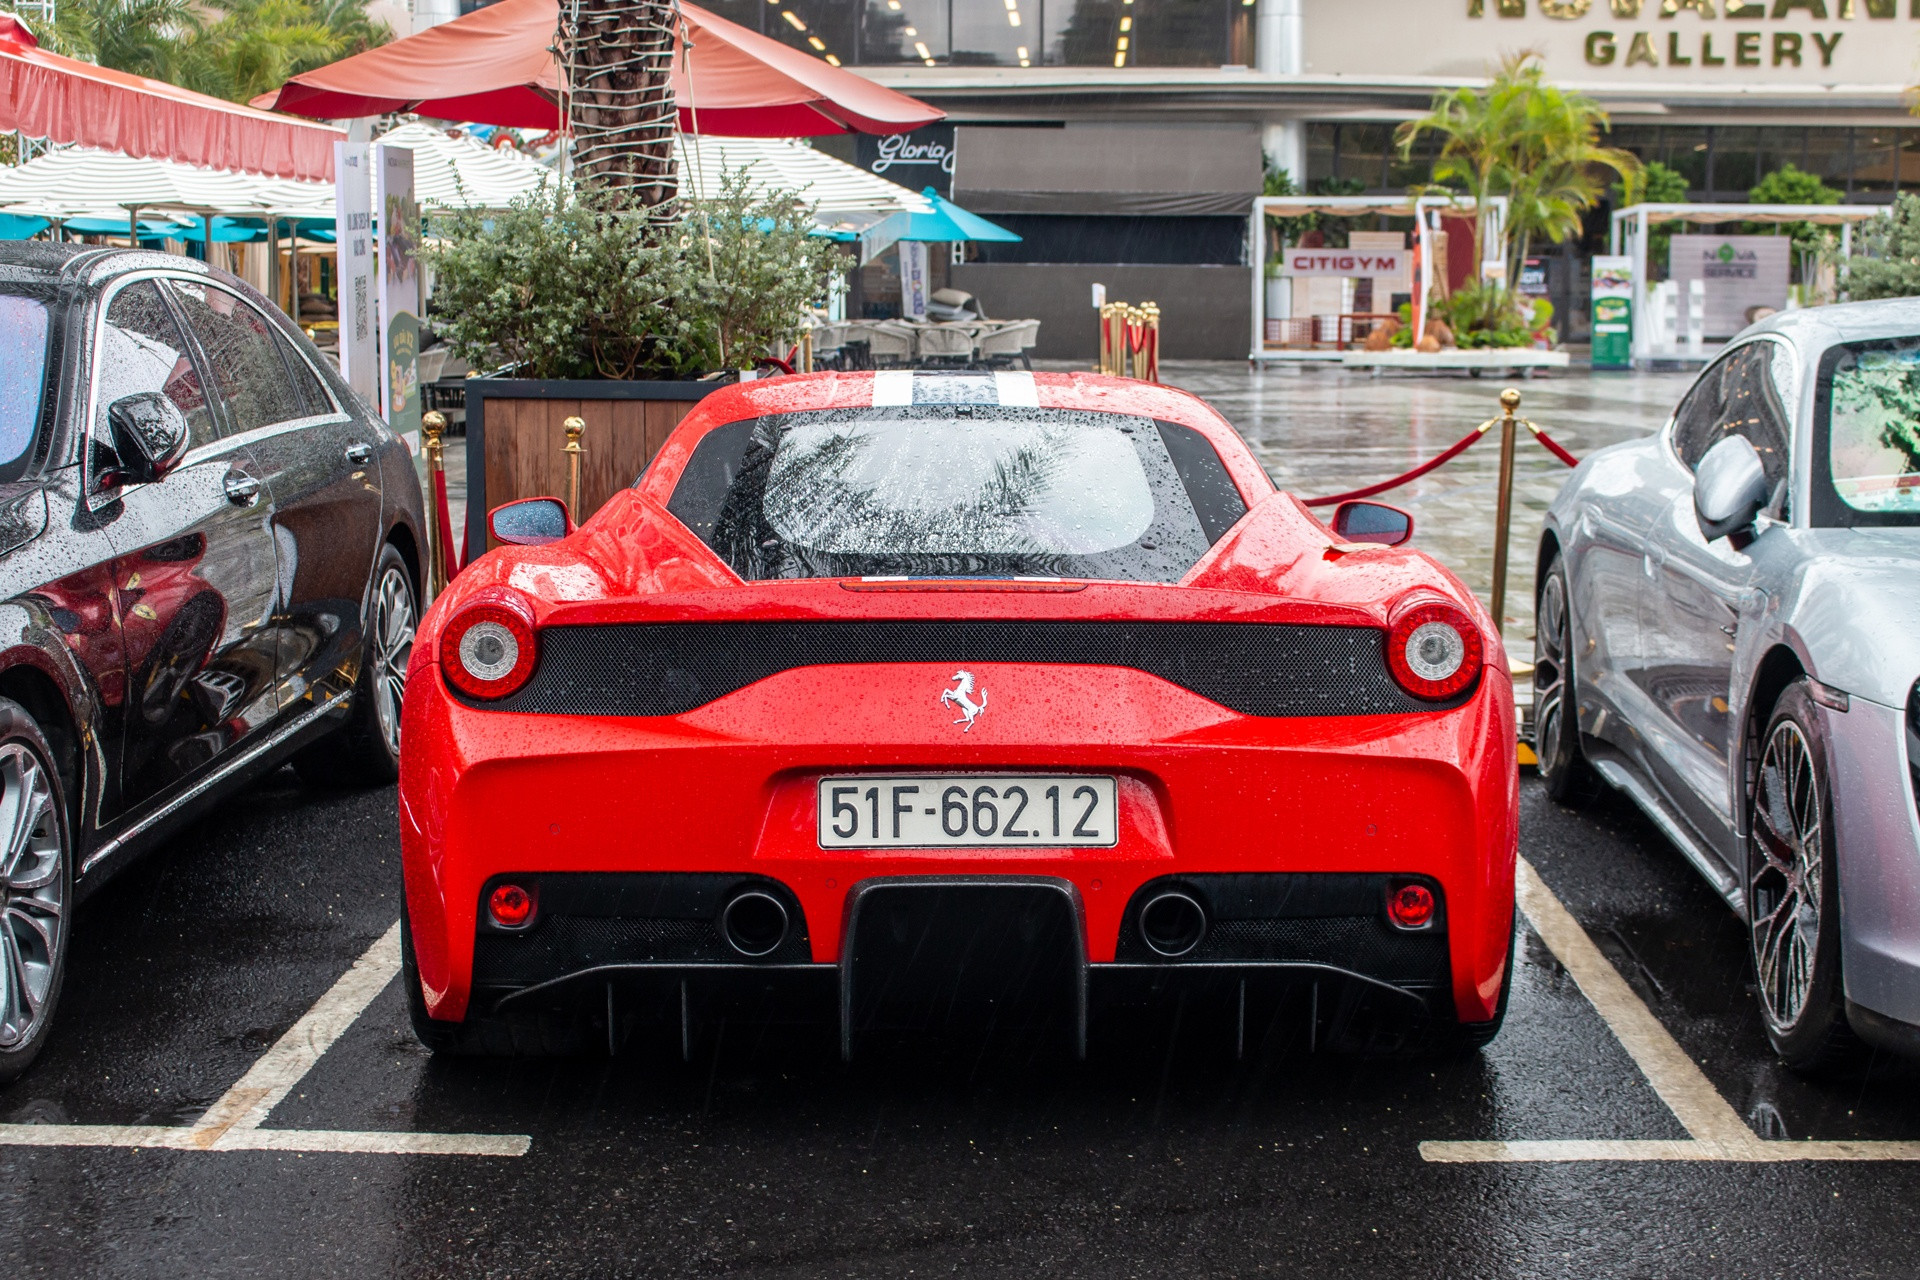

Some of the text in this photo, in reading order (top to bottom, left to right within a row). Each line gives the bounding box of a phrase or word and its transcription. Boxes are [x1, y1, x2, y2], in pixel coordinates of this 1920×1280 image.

[1584, 31, 1844, 67] GALLERY
[871, 134, 946, 173] Gloria
[1293, 256, 1396, 270] CITIGYM
[832, 785, 1099, 839] 51F-662.12
